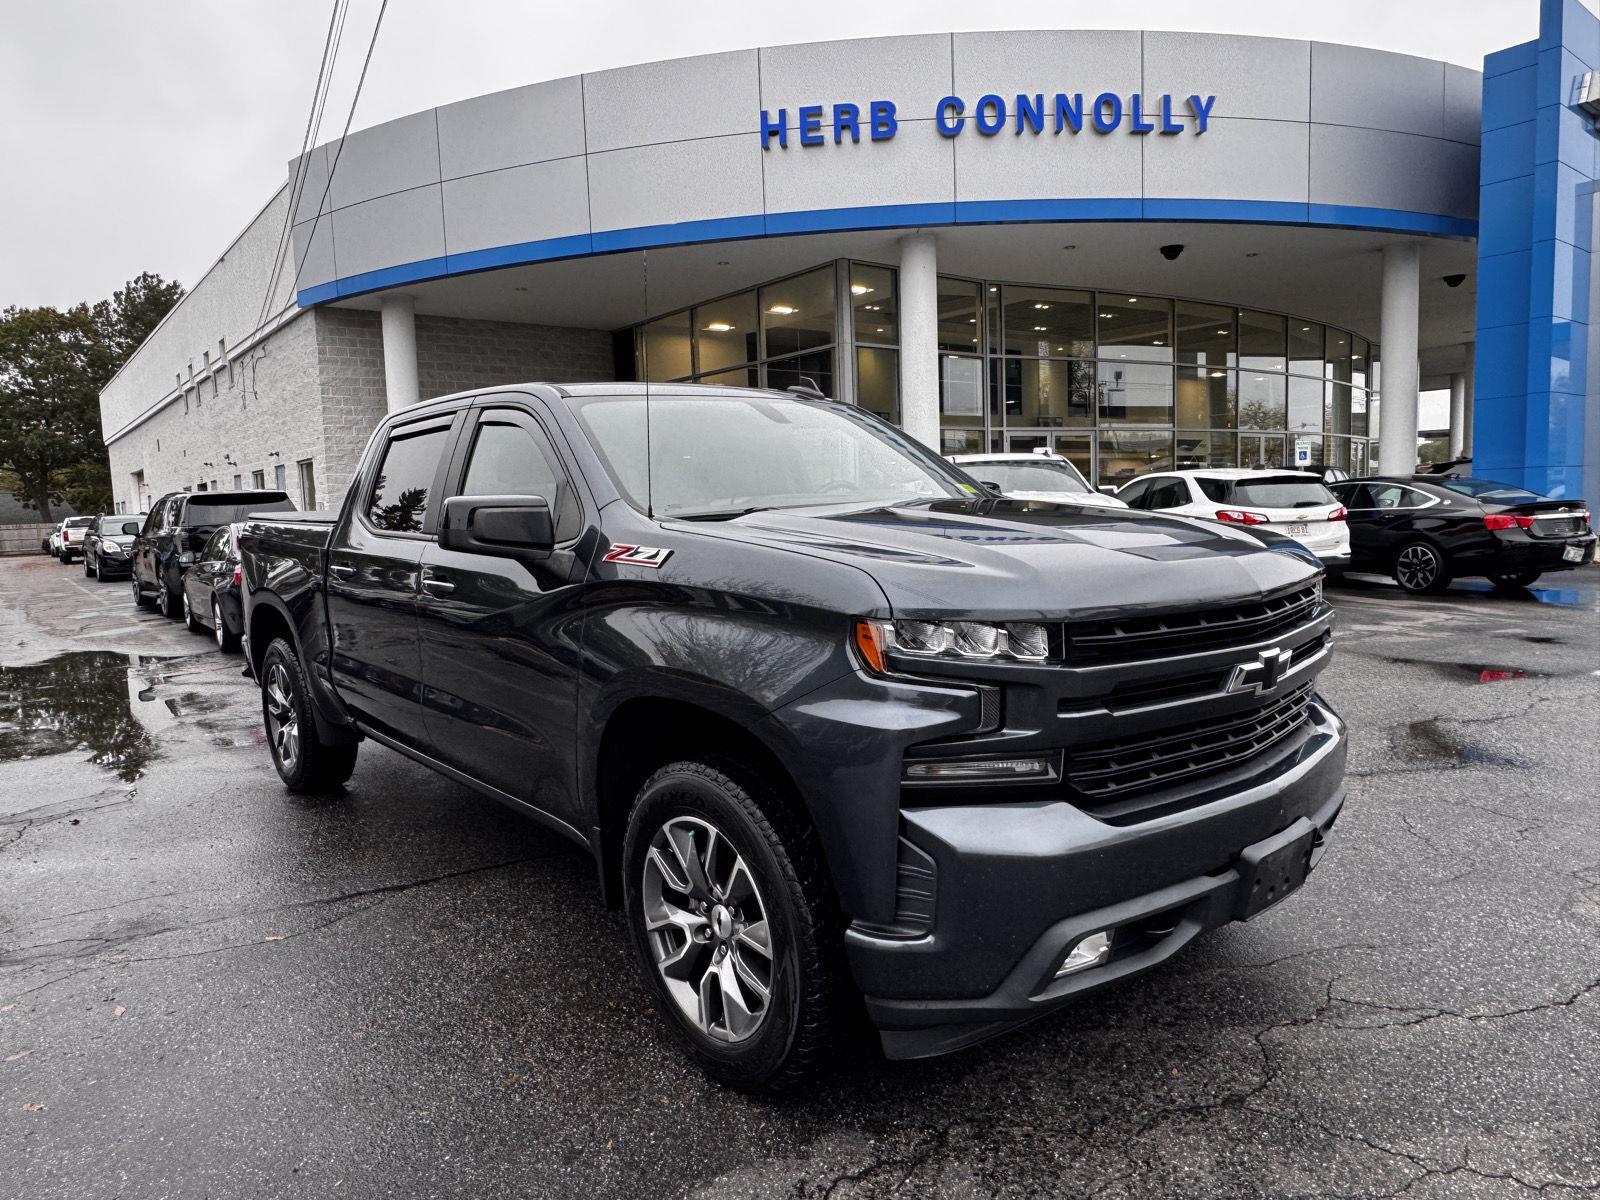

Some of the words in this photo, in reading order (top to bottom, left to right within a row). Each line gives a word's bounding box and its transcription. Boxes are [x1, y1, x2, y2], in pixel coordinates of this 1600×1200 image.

[760, 100, 898, 150] HERB
[936, 92, 1216, 138] CONNOLLY
[602, 543, 673, 568] Z71
